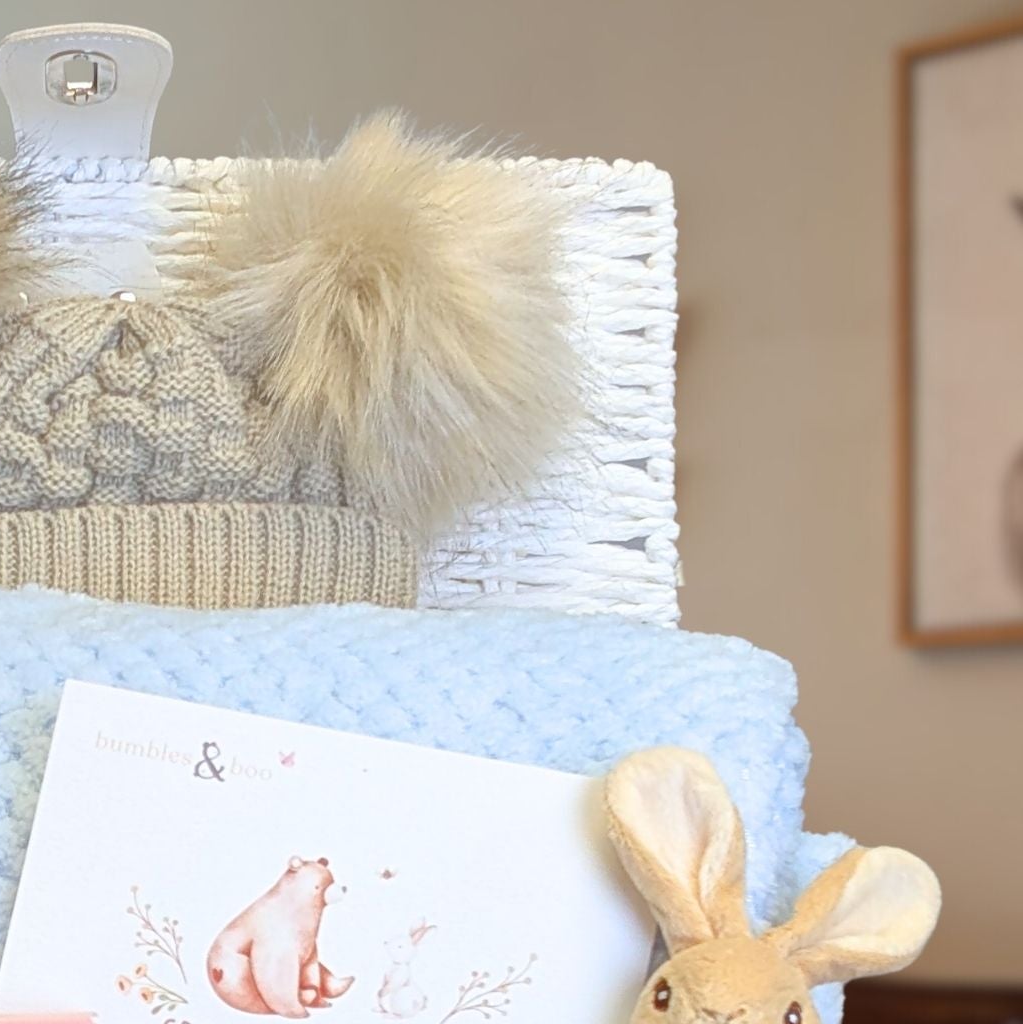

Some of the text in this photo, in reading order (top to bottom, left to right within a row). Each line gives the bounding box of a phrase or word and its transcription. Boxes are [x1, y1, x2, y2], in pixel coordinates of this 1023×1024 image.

[95, 731, 273, 782] bumbles & boo
